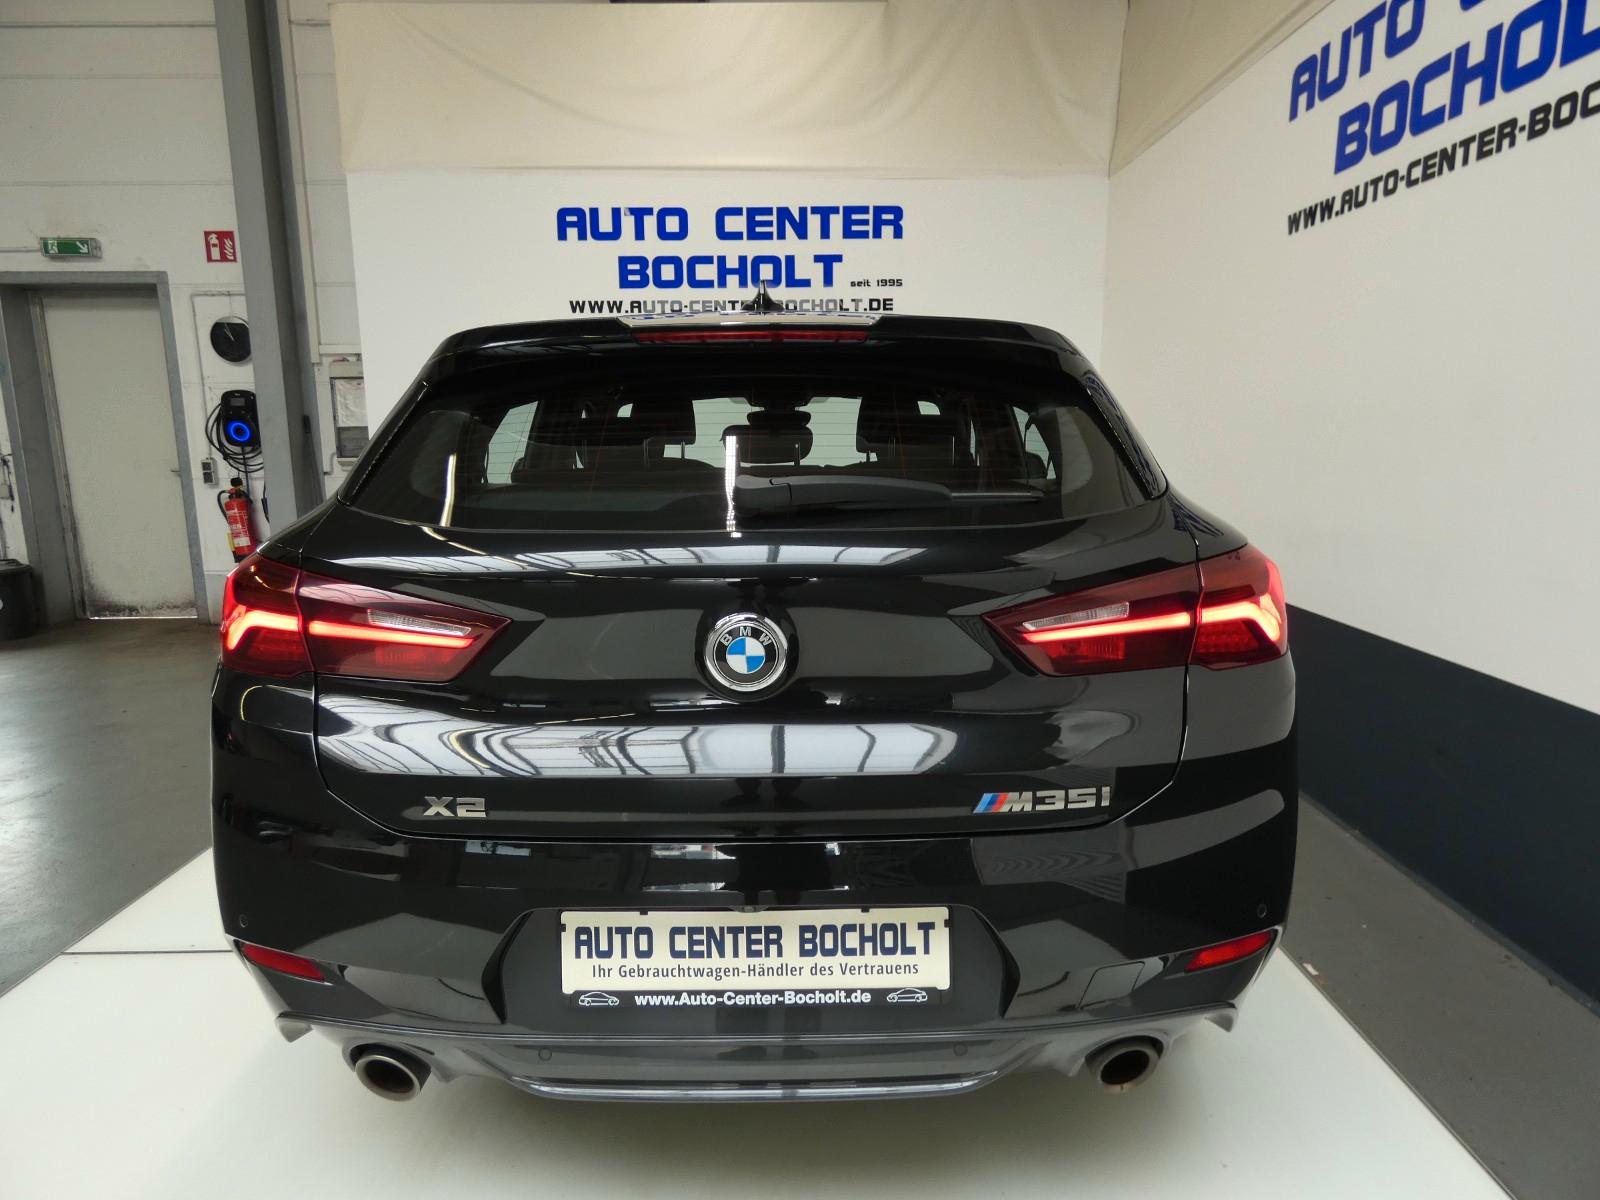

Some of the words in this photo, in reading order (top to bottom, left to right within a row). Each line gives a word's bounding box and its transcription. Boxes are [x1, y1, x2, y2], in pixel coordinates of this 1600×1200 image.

[1289, 0, 1426, 122] AUTO
[556, 207, 689, 241] AUTO
[715, 205, 904, 240] CENTER
[618, 254, 843, 289] BOCHOLT
[850, 279, 871, 287] seit
[876, 278, 903, 287] 1995
[720, 626, 772, 646] BMW
[423, 796, 487, 818] X2
[574, 926, 653, 959] AUTO
[669, 925, 783, 959] CENTER
[799, 921, 935, 957] BOCHOLT
[592, 964, 612, 978] Ihr
[618, 962, 804, 981] Gebrauchtwagen-Händler
[810, 963, 834, 976] des
[839, 961, 919, 976] Vertrauens
[634, 989, 872, 1006] www.Auto-Center-Bocholt.de
